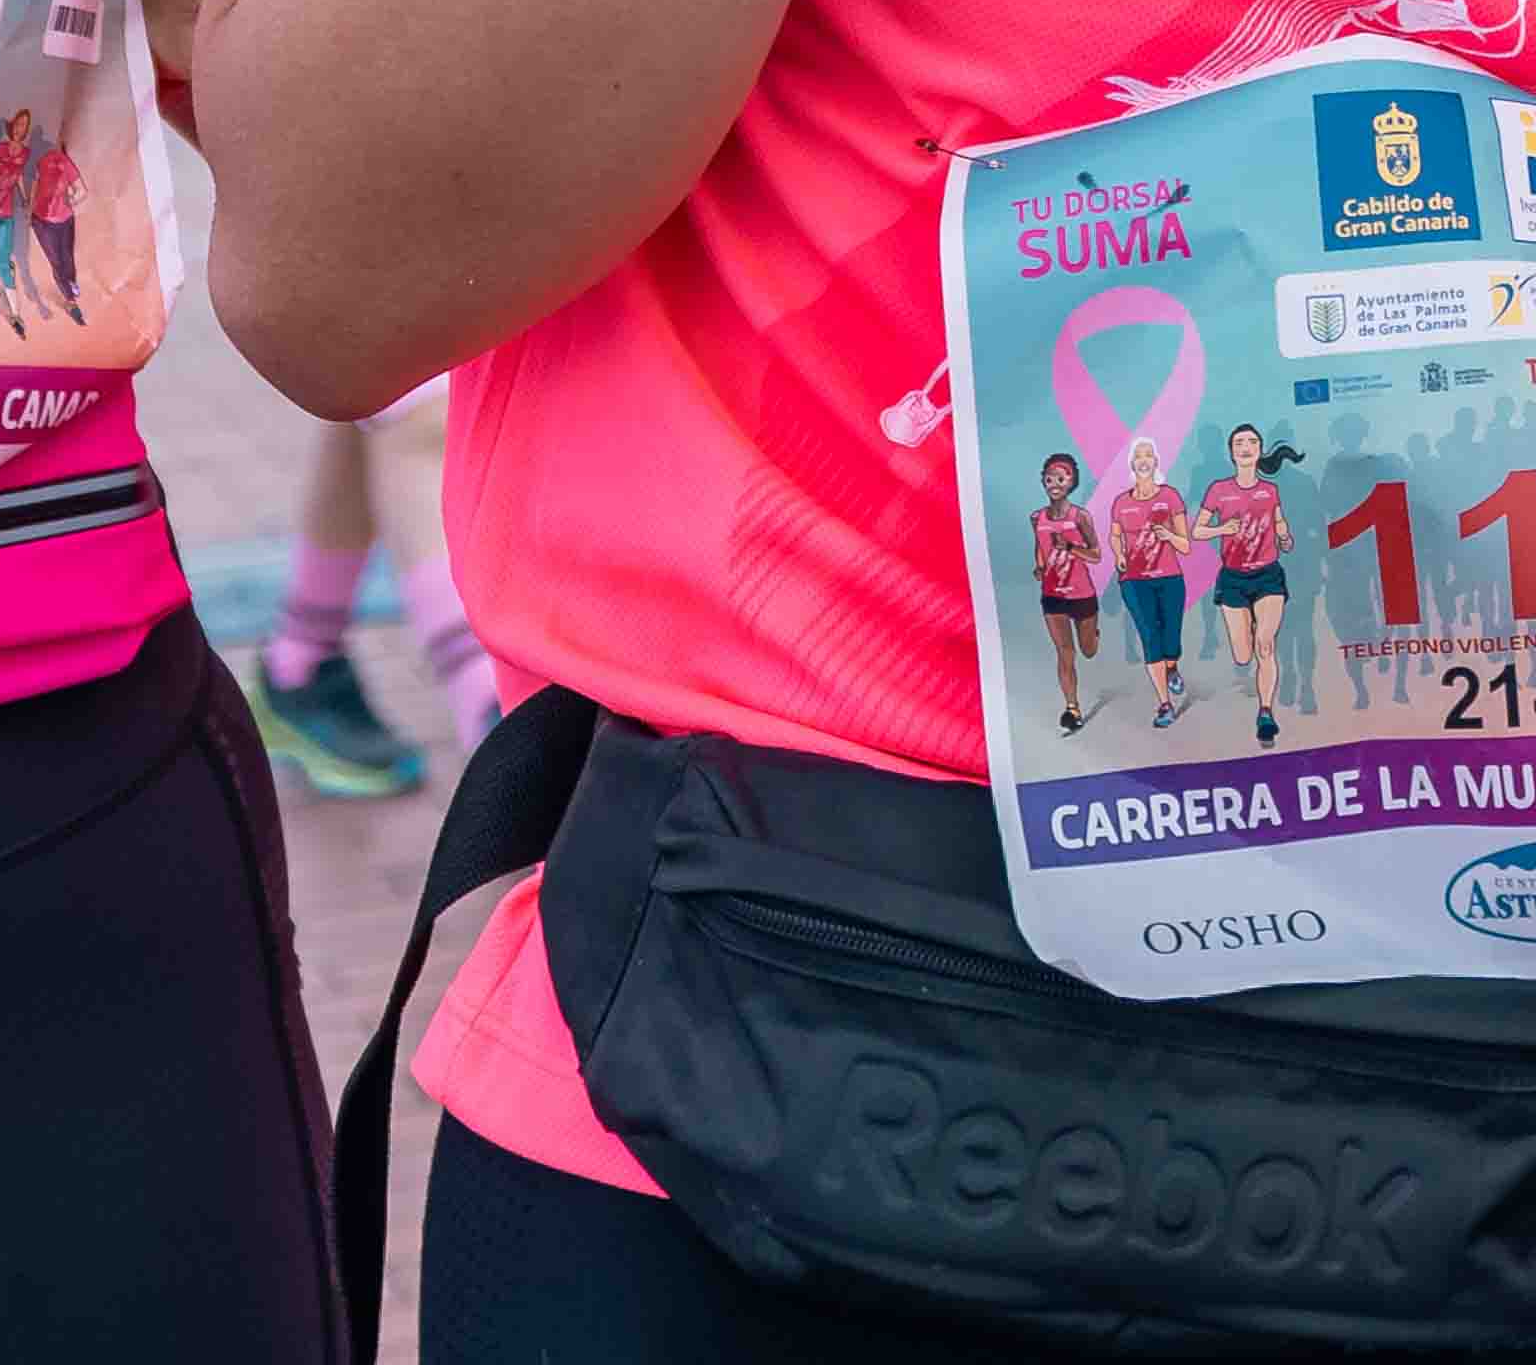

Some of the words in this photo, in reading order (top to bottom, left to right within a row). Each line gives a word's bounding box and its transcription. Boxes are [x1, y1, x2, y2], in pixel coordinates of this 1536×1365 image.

[1011, 196, 1052, 223] TU
[1064, 178, 1192, 218] DORSAL
[1343, 191, 1424, 217] Cabildo
[1430, 191, 1454, 211] de
[1334, 215, 1386, 239] Gran
[1390, 212, 1470, 236] Canaria
[1017, 212, 1193, 279] SUMA
[1356, 288, 1465, 308] Ayuntamiento
[1356, 307, 1375, 322] de
[1383, 306, 1407, 321] Las
[1415, 301, 1467, 318] Palmas
[1357, 322, 1375, 337] de
[1378, 321, 1413, 337] Gran
[1415, 316, 1468, 334] Canaria
[1341, 636, 1453, 661] TELÉFONO
[1050, 782, 1282, 851] CARRERA
[1297, 771, 1362, 821] DE
[1379, 763, 1440, 811] LA
[1143, 909, 1327, 955] OYSHO
[826, 1050, 1423, 1275] Reebok
